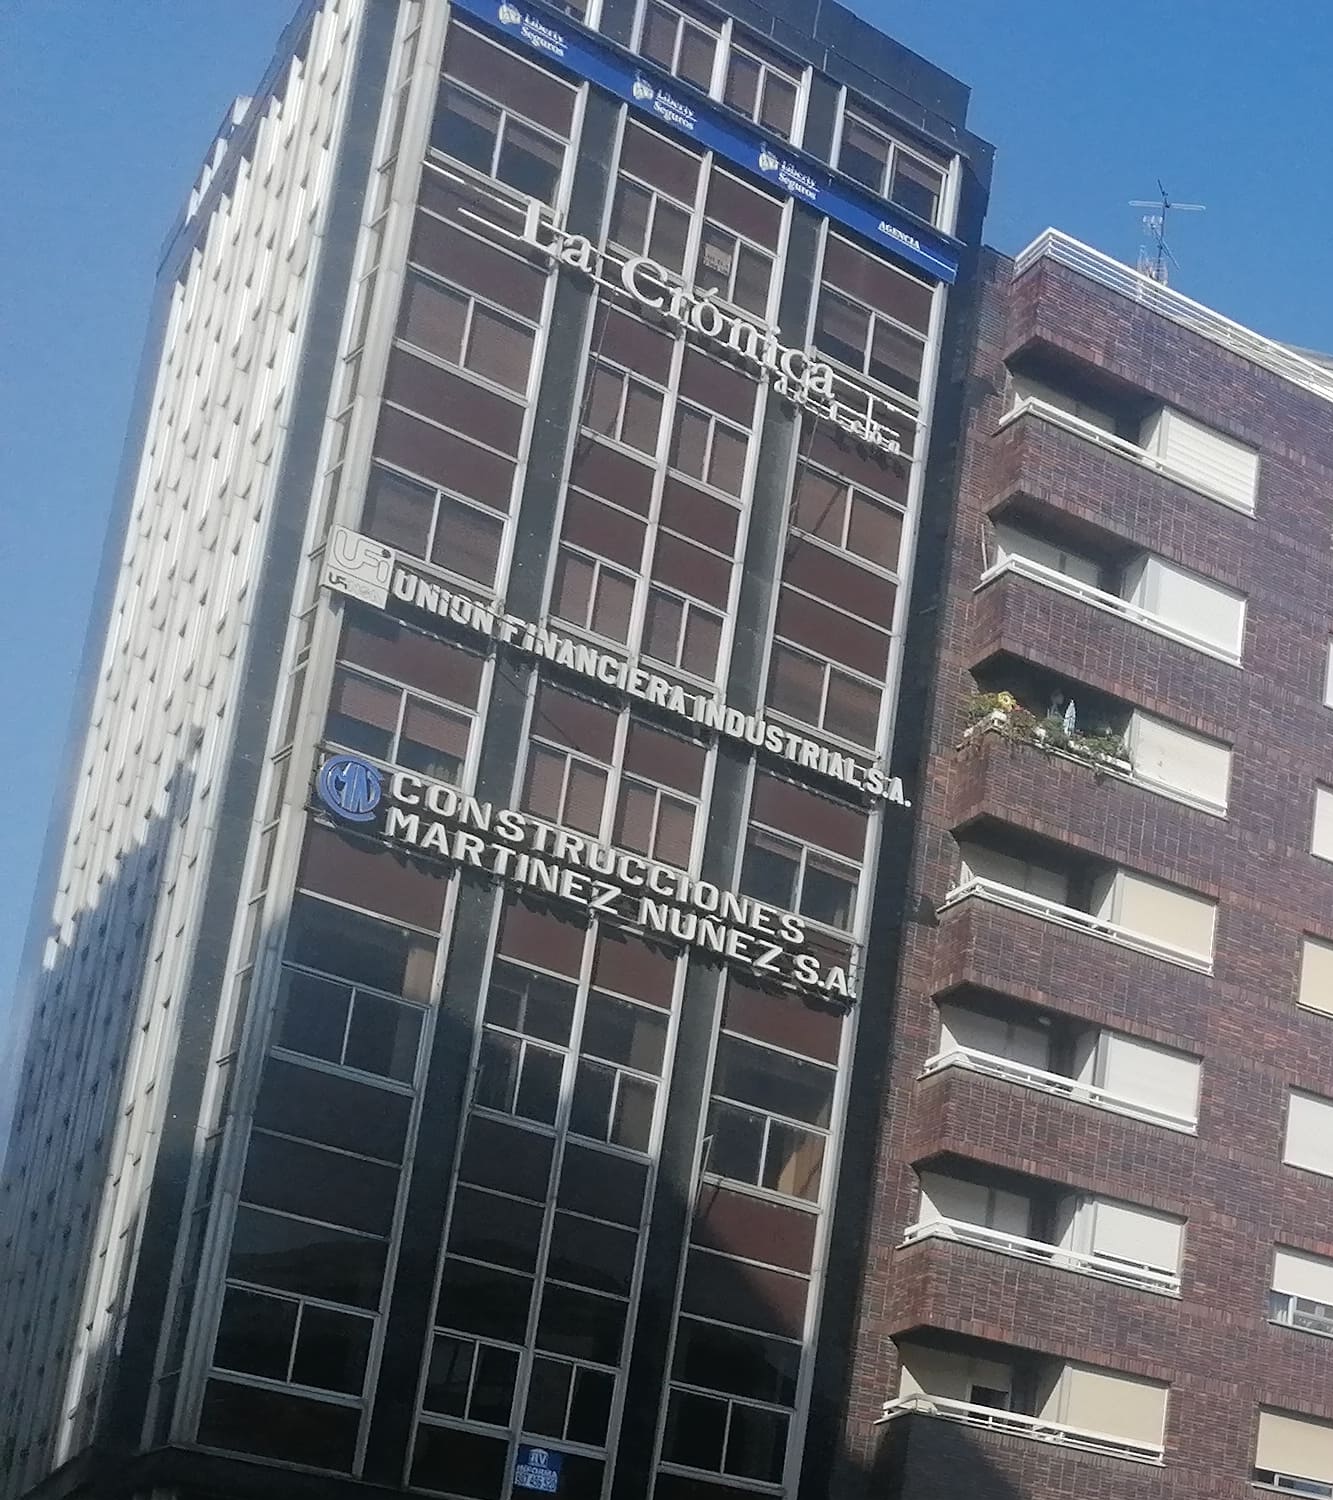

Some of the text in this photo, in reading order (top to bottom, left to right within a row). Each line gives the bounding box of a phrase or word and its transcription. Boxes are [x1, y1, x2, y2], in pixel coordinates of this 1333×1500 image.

[520, 26, 564, 57] Seguros
[653, 100, 695, 131] Seguros
[777, 172, 817, 200] Seguros
[877, 220, 921, 250] AGENCIA
[519, 197, 835, 400] La Crónica
[500, 613, 688, 716] FINANCIERA
[692, 693, 864, 792] INDUSTRIAL
[864, 764, 912, 808] S.A.
[383, 805, 622, 915] MARTINEZ
[636, 896, 784, 974] NUÑEZ
[389, 771, 807, 945] CONSTRUCCIONES
